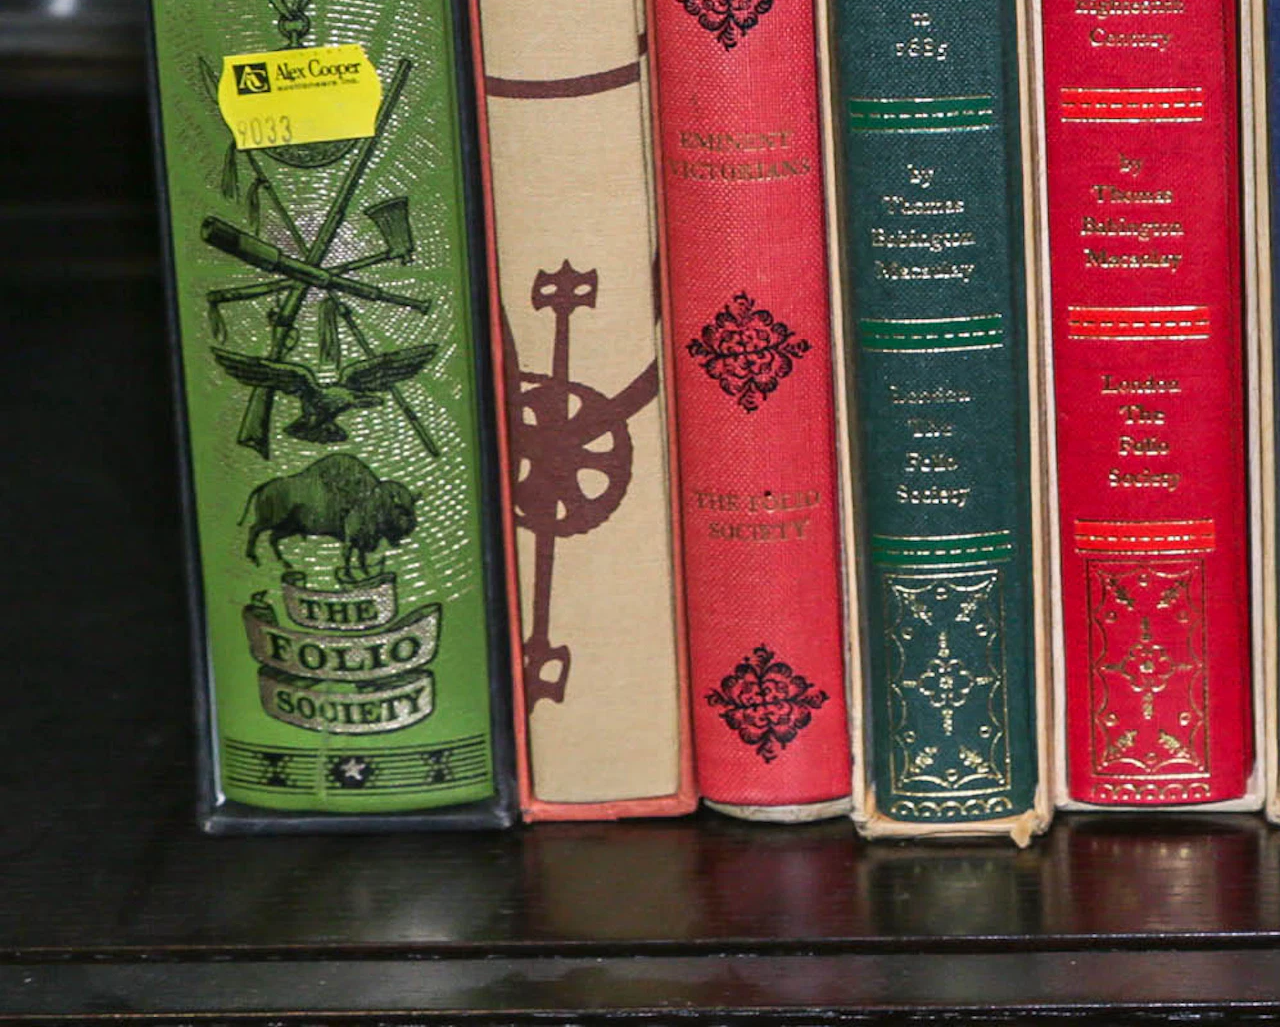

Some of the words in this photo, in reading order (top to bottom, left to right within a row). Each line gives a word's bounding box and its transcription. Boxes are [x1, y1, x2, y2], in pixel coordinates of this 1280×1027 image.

[276, 62, 305, 81] Alex
[308, 59, 362, 80] Cooper
[237, 115, 292, 147] 9033
[1118, 153, 1143, 177] by
[1090, 184, 1173, 204] Thomas
[1101, 374, 1182, 394] London
[1119, 404, 1165, 425] The
[302, 599, 378, 621] THE
[266, 632, 420, 671] FOLIO
[276, 688, 425, 722] SOCIETY
